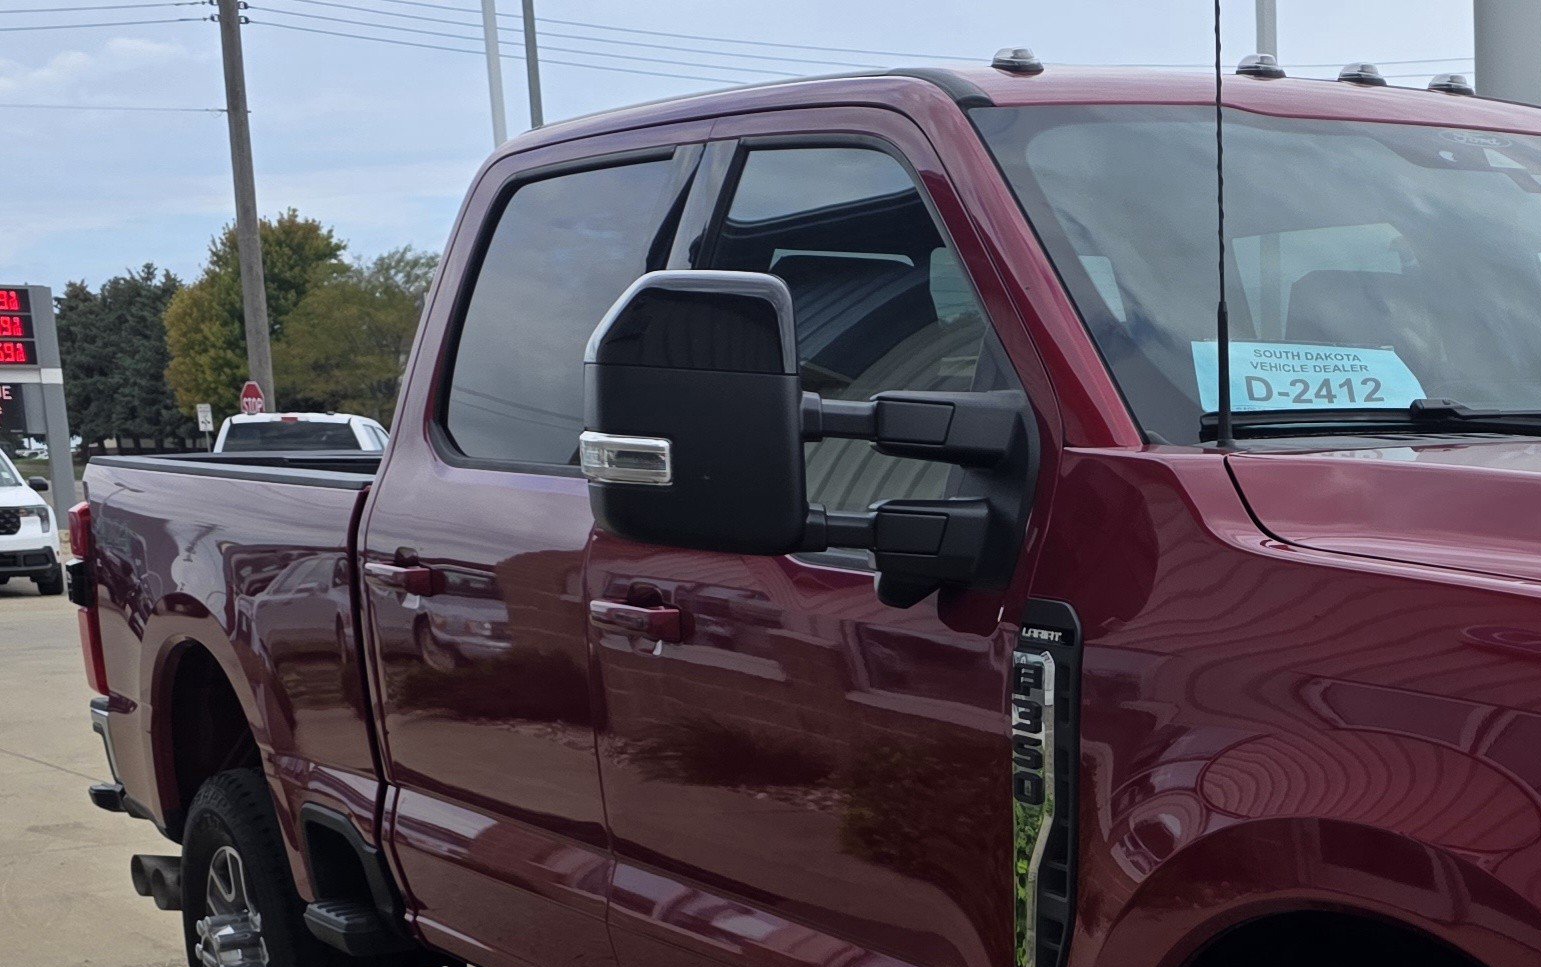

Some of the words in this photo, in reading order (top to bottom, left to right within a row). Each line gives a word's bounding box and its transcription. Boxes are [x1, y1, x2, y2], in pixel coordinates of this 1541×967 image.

[1253, 349, 1300, 361] SOUTH
[1305, 351, 1361, 362] DAKOTA
[1250, 361, 1308, 373] VEHICLE
[1313, 363, 1369, 373] DEALER
[1245, 375, 1385, 404] D-2412
[242, 397, 263, 413] STOP
[1021, 626, 1063, 643] LARIAT
